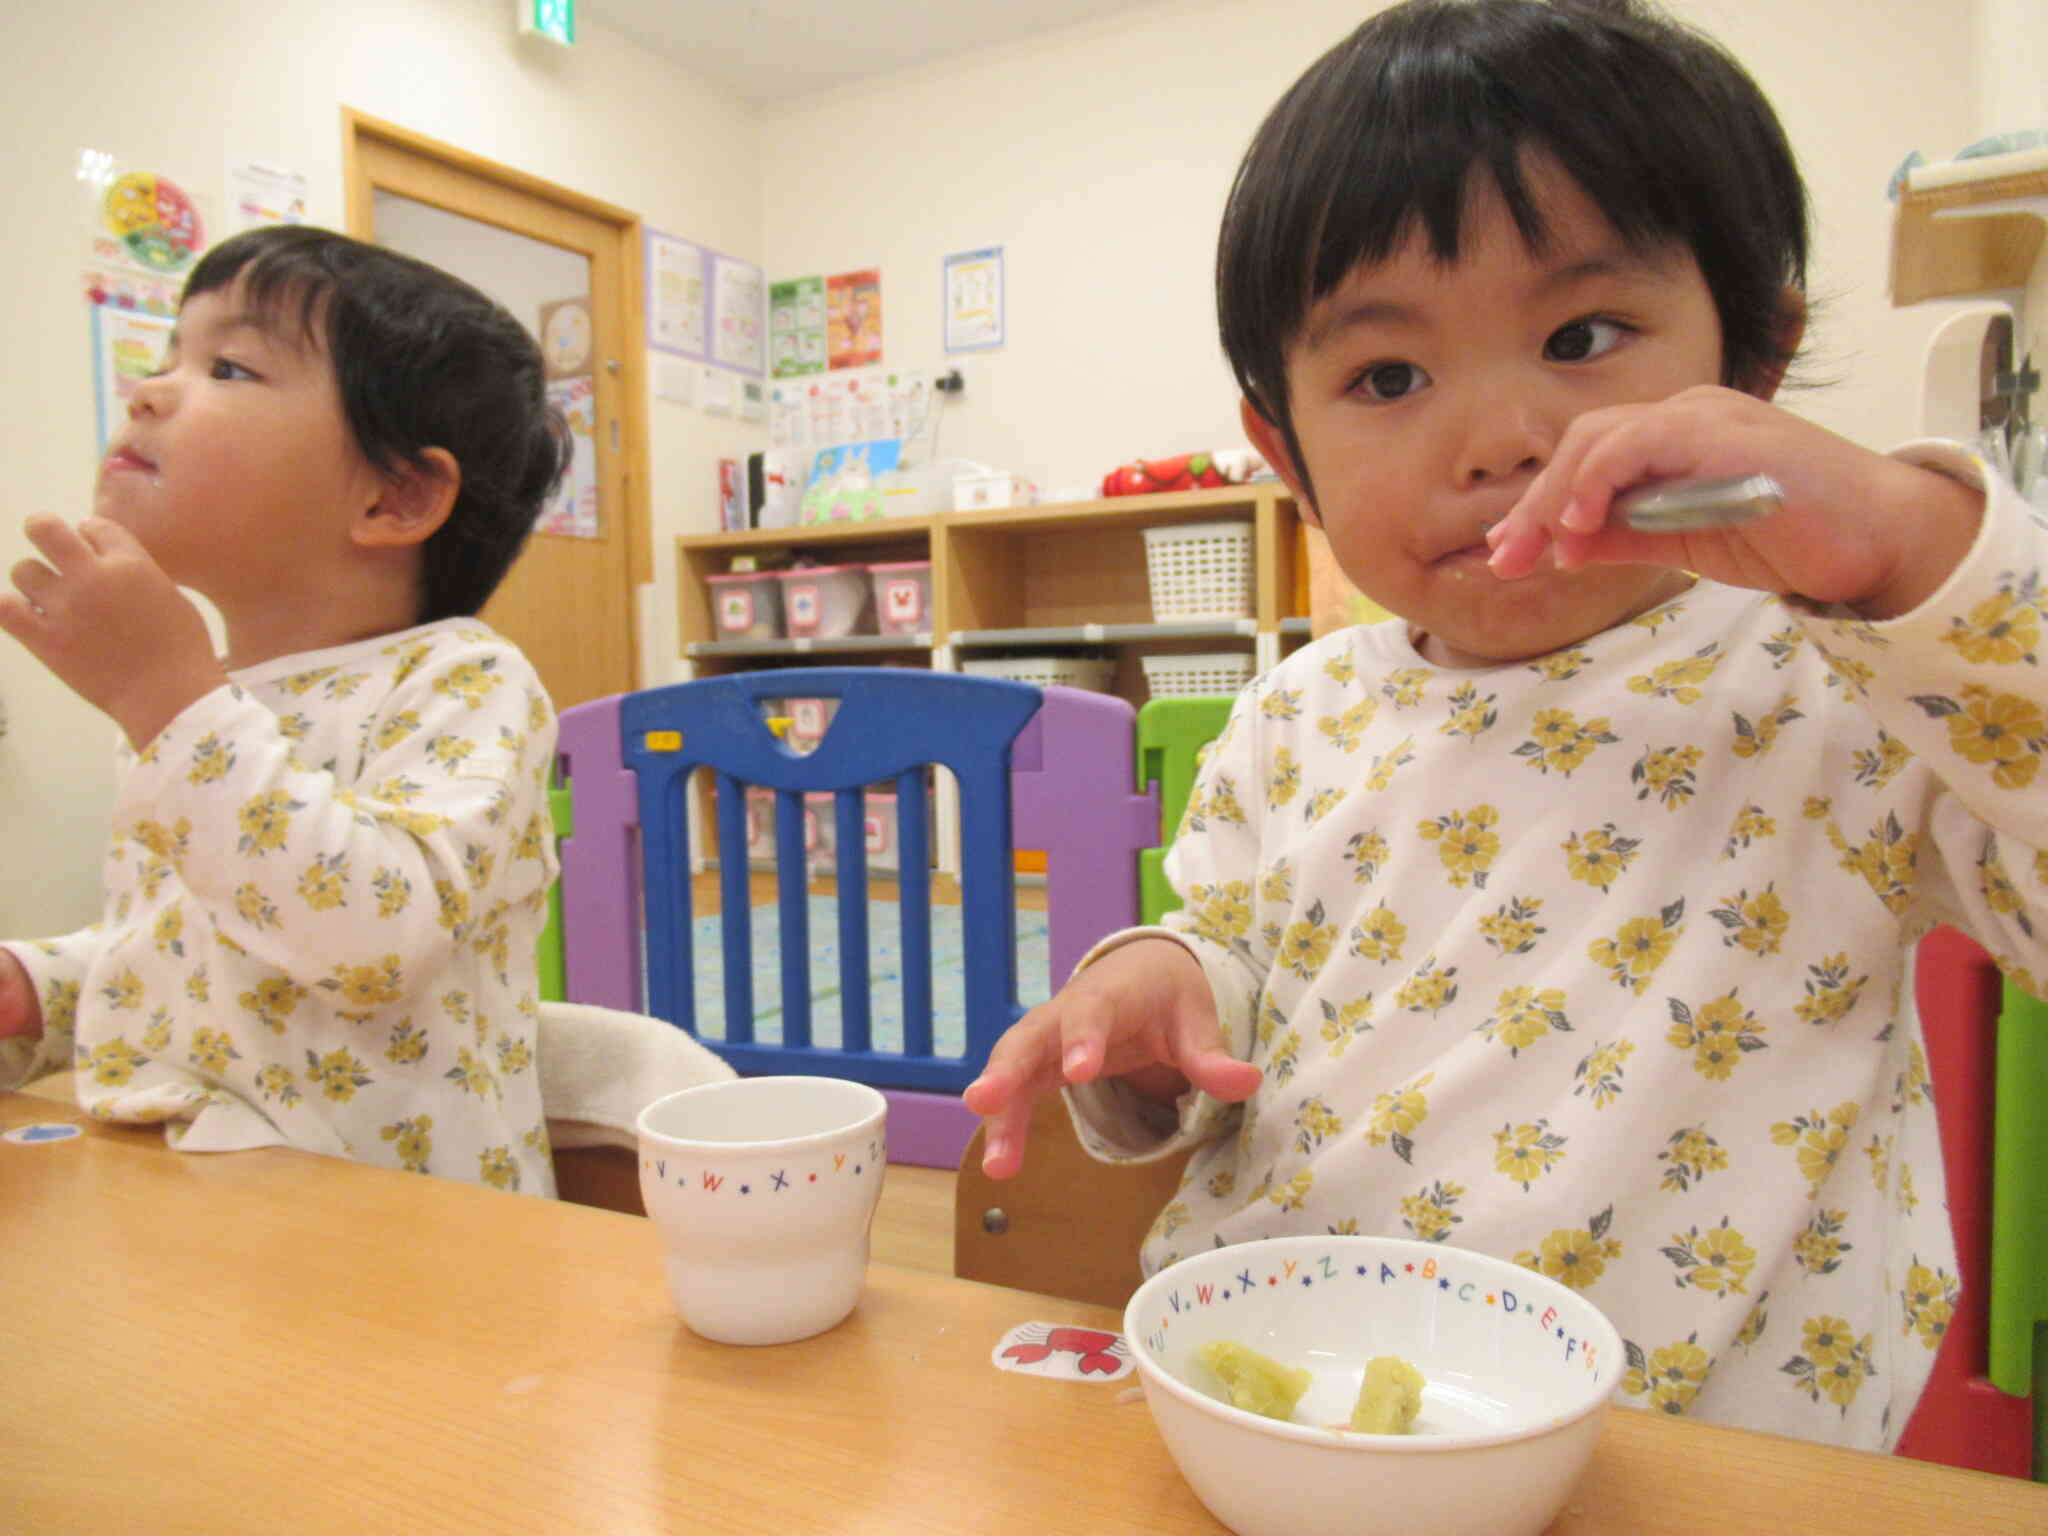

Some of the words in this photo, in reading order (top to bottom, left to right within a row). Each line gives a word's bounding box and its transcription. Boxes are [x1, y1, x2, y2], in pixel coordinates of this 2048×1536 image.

[703, 1169, 724, 1192] W
[770, 1169, 789, 1192] X
[1168, 1289, 1180, 1313] V
[1196, 1282, 1215, 1305] W
[1236, 1268, 1256, 1294] X
[1282, 1258, 1298, 1280] Y
[1317, 1255, 1339, 1279] Z
[1380, 1261, 1396, 1284] A
[1421, 1257, 1439, 1280] B
[1458, 1282, 1476, 1302] C
[1502, 1289, 1518, 1312] D
[1540, 1306, 1559, 1331] E
[1565, 1337, 1577, 1361] F
